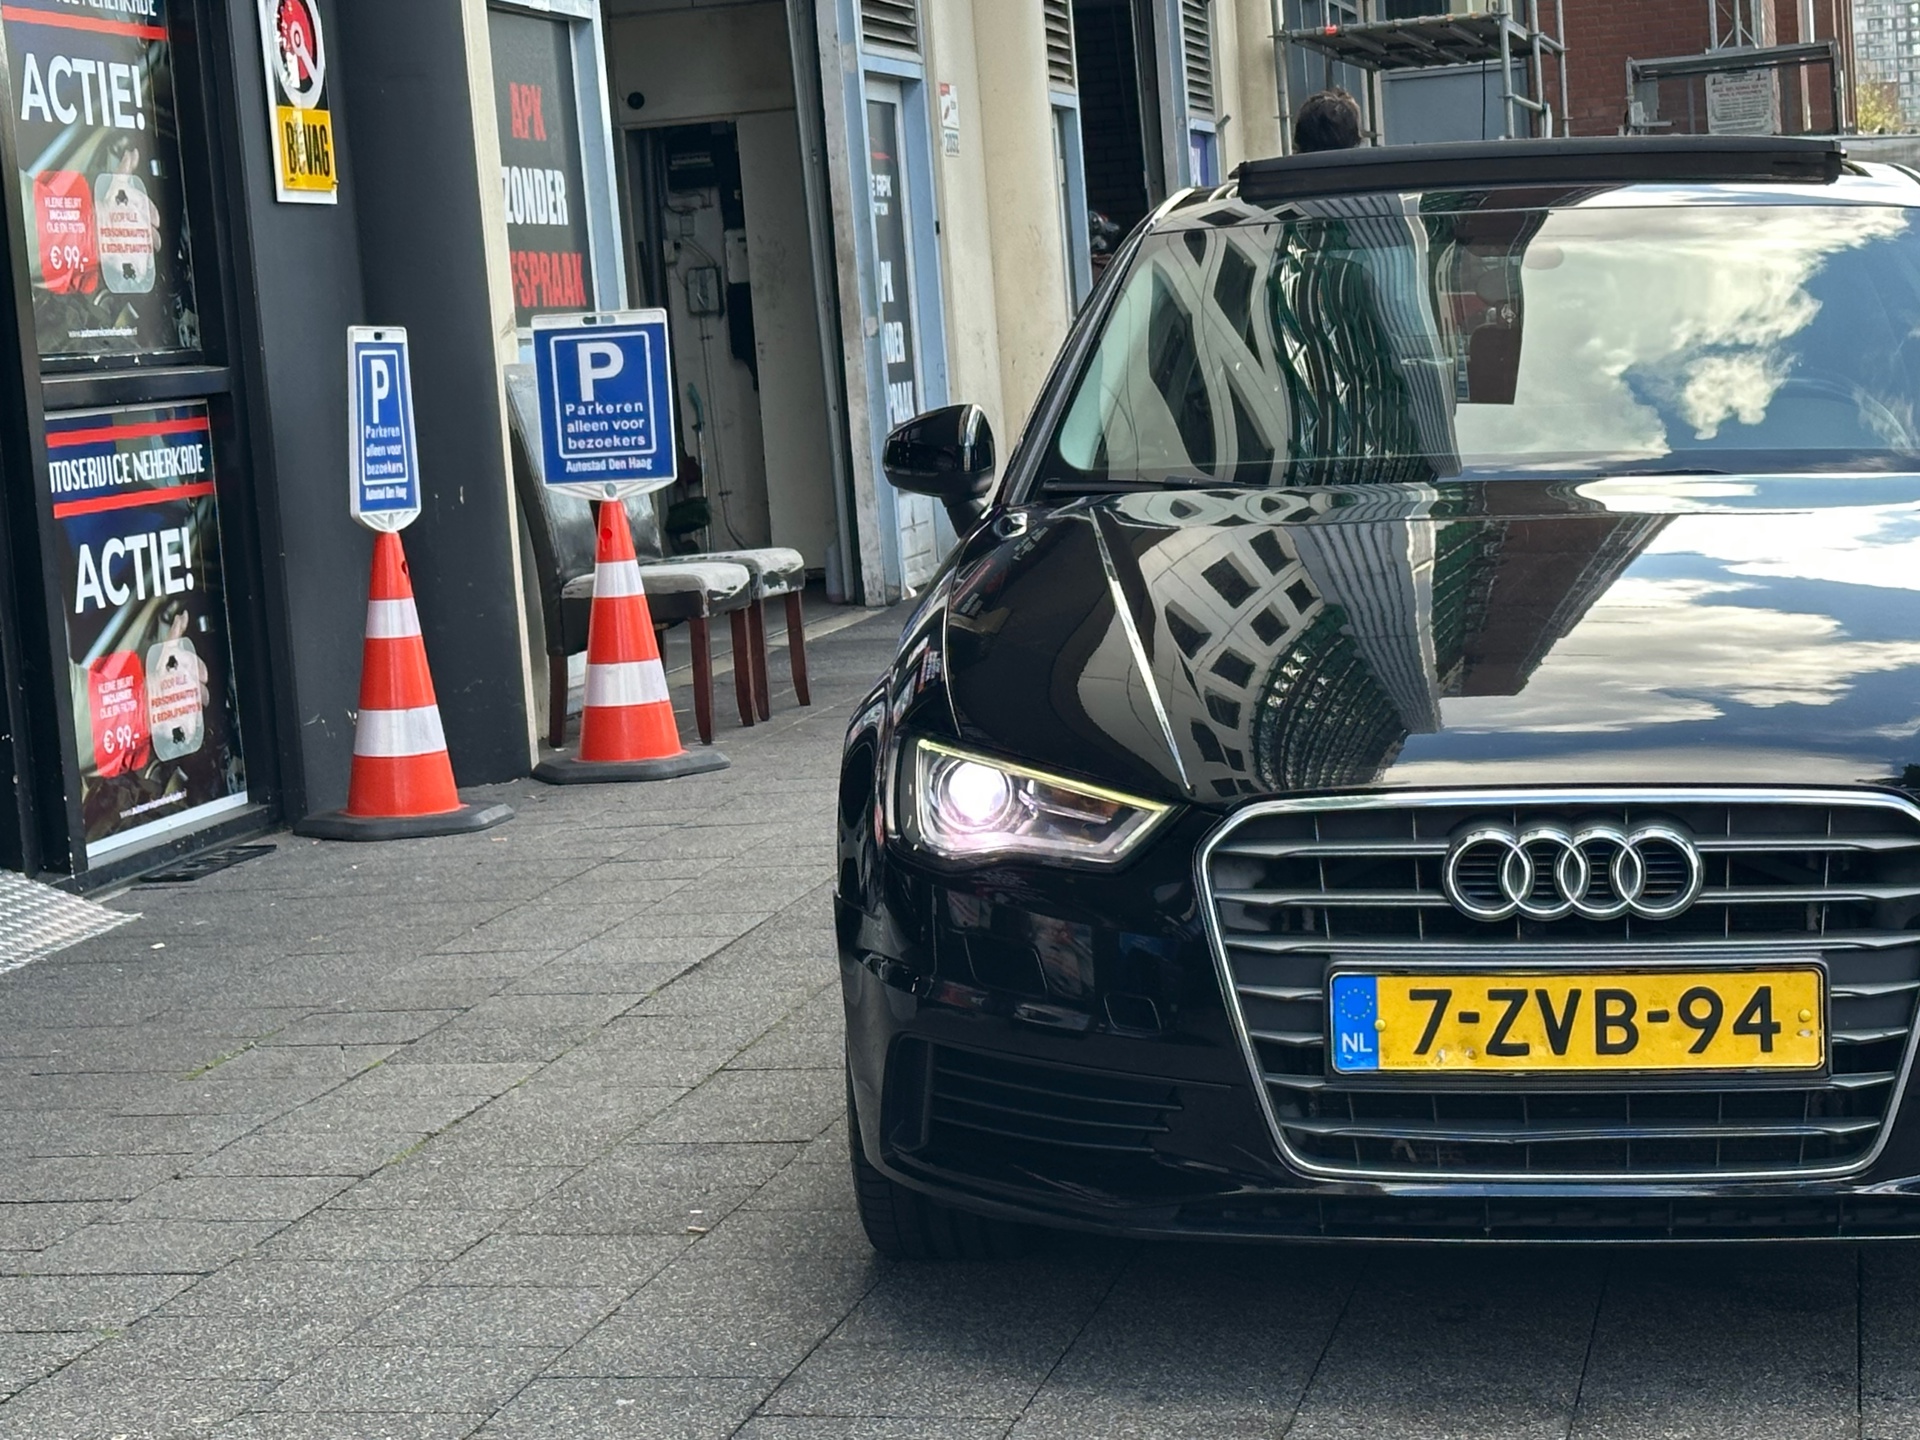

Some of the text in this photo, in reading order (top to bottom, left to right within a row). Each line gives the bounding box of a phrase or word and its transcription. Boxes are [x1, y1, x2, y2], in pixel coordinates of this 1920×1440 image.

[21, 52, 146, 130] ACTIE!
[510, 82, 547, 141] APK
[501, 166, 569, 226] ZONDER
[50, 245, 62, 270] €
[577, 342, 624, 402] P
[371, 359, 389, 424] P
[565, 402, 644, 416] Parkeren
[366, 425, 400, 439] Parkeren
[566, 419, 645, 433] alleen voor
[366, 443, 402, 457] alleen voor
[568, 434, 646, 449] bezoekers
[132, 443, 205, 482] NEHERKADE
[366, 460, 404, 476] bezoekers
[566, 456, 653, 473] Autostad Den Haag
[75, 526, 194, 614] ACTIE!
[103, 729, 115, 754] €
[1409, 986, 1781, 1056] 7-ZVB-94
[1341, 1033, 1372, 1054] NL
